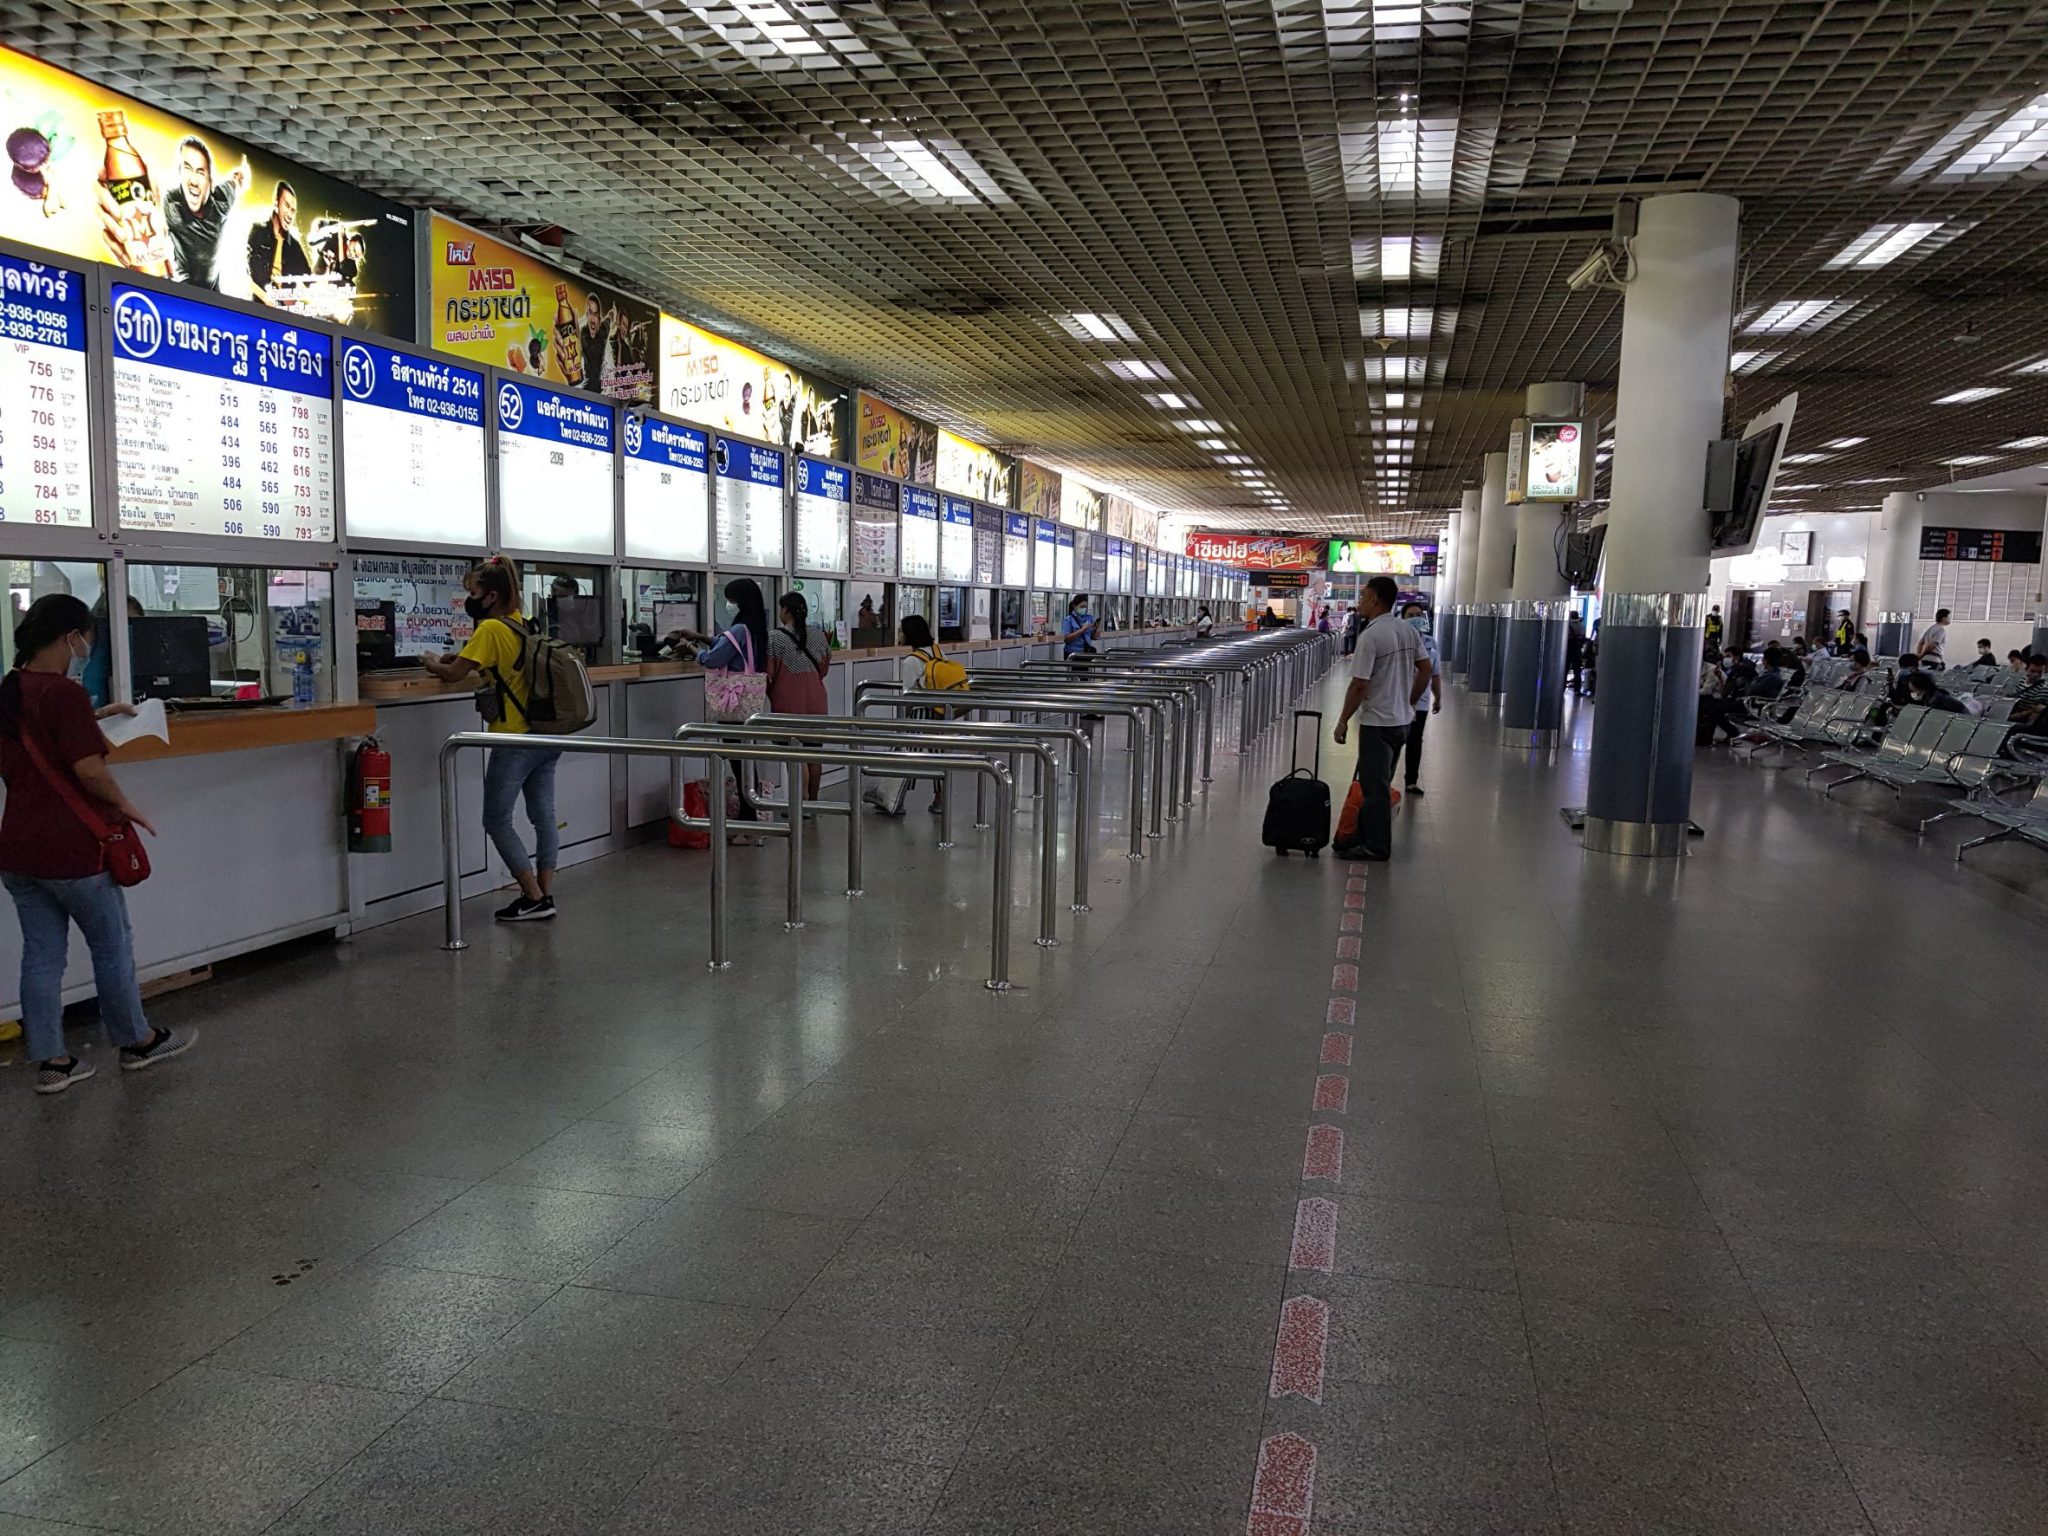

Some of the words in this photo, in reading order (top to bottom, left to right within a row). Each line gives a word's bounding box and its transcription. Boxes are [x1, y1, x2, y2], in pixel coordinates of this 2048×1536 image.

[448, 243, 471, 262] ใหม่
[446, 288, 530, 323] กระชายดำ
[14, 343, 30, 354] VIP
[120, 306, 156, 345] 51ก
[167, 318, 249, 377] เขมราฐ
[257, 329, 322, 382] รุ่งเรือง
[28, 360, 53, 377] 756
[348, 356, 370, 388] 51
[392, 356, 449, 392] อีสานทัวร์
[452, 377, 478, 399] 2514
[30, 385, 54, 401] 776
[221, 394, 239, 408] 515
[259, 401, 277, 414] 599
[292, 407, 309, 419] 798
[407, 387, 425, 410] โทร
[427, 398, 478, 421] 02-936-0155
[501, 392, 520, 420] 52
[537, 396, 609, 430] แอร์โคราชพัฒนา
[31, 410, 55, 426] 706
[221, 416, 239, 428] 484
[259, 422, 277, 434] 565
[293, 427, 309, 439] 753
[33, 435, 56, 450] 594
[560, 422, 571, 438] โทร
[573, 429, 608, 447] 02-936-2252
[627, 424, 640, 447] 53
[222, 436, 240, 448] 434
[261, 441, 277, 454] 506
[293, 447, 310, 458] 675
[34, 460, 57, 475] 885
[222, 455, 240, 468] 396
[261, 462, 278, 473] 462
[294, 465, 310, 477] 616
[34, 485, 58, 499] 784
[223, 477, 241, 489] 484
[262, 481, 279, 493] 565
[294, 486, 311, 497] 753
[35, 509, 57, 523] 851
[224, 499, 242, 511] 506
[262, 502, 279, 514] 590
[295, 506, 311, 517] 793
[224, 522, 243, 534] 506
[264, 525, 280, 537] 590
[296, 528, 312, 539] 793
